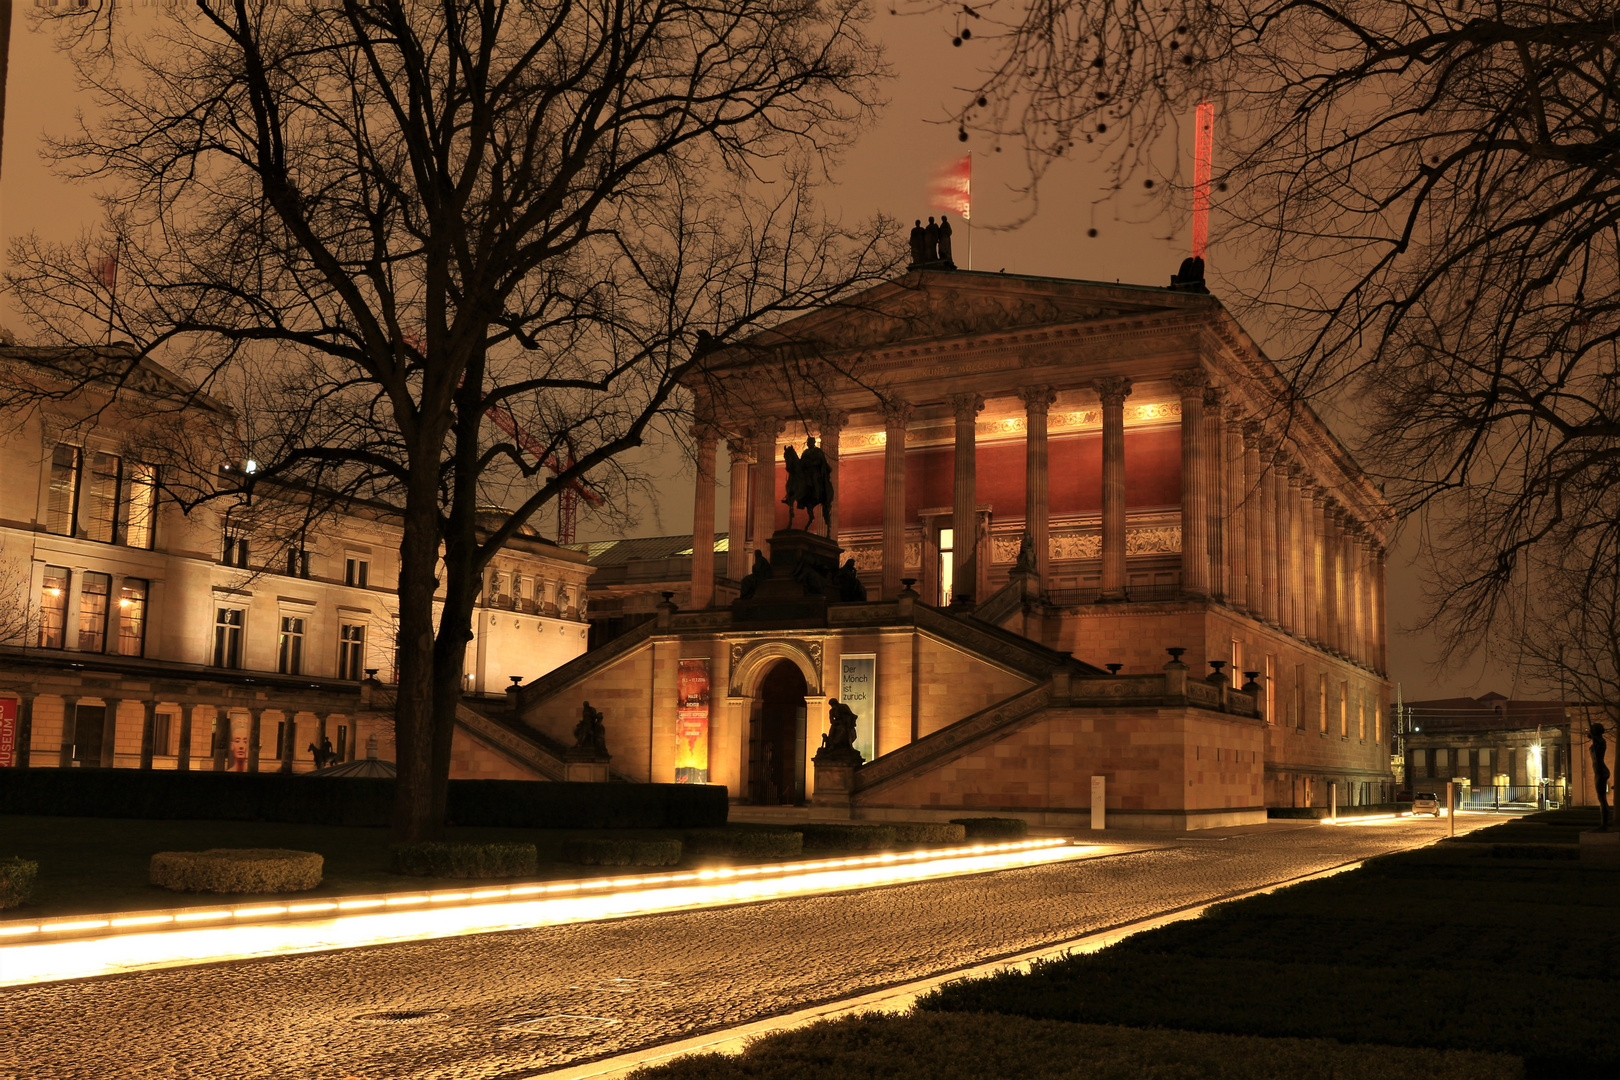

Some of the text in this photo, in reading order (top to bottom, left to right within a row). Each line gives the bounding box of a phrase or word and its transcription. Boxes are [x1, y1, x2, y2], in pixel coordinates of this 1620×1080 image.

[922, 366, 951, 377] KUNST
[843, 665, 857, 673] Der
[843, 674, 868, 683] Mönch
[843, 683, 852, 692] ist
[843, 692, 867, 701] zurück
